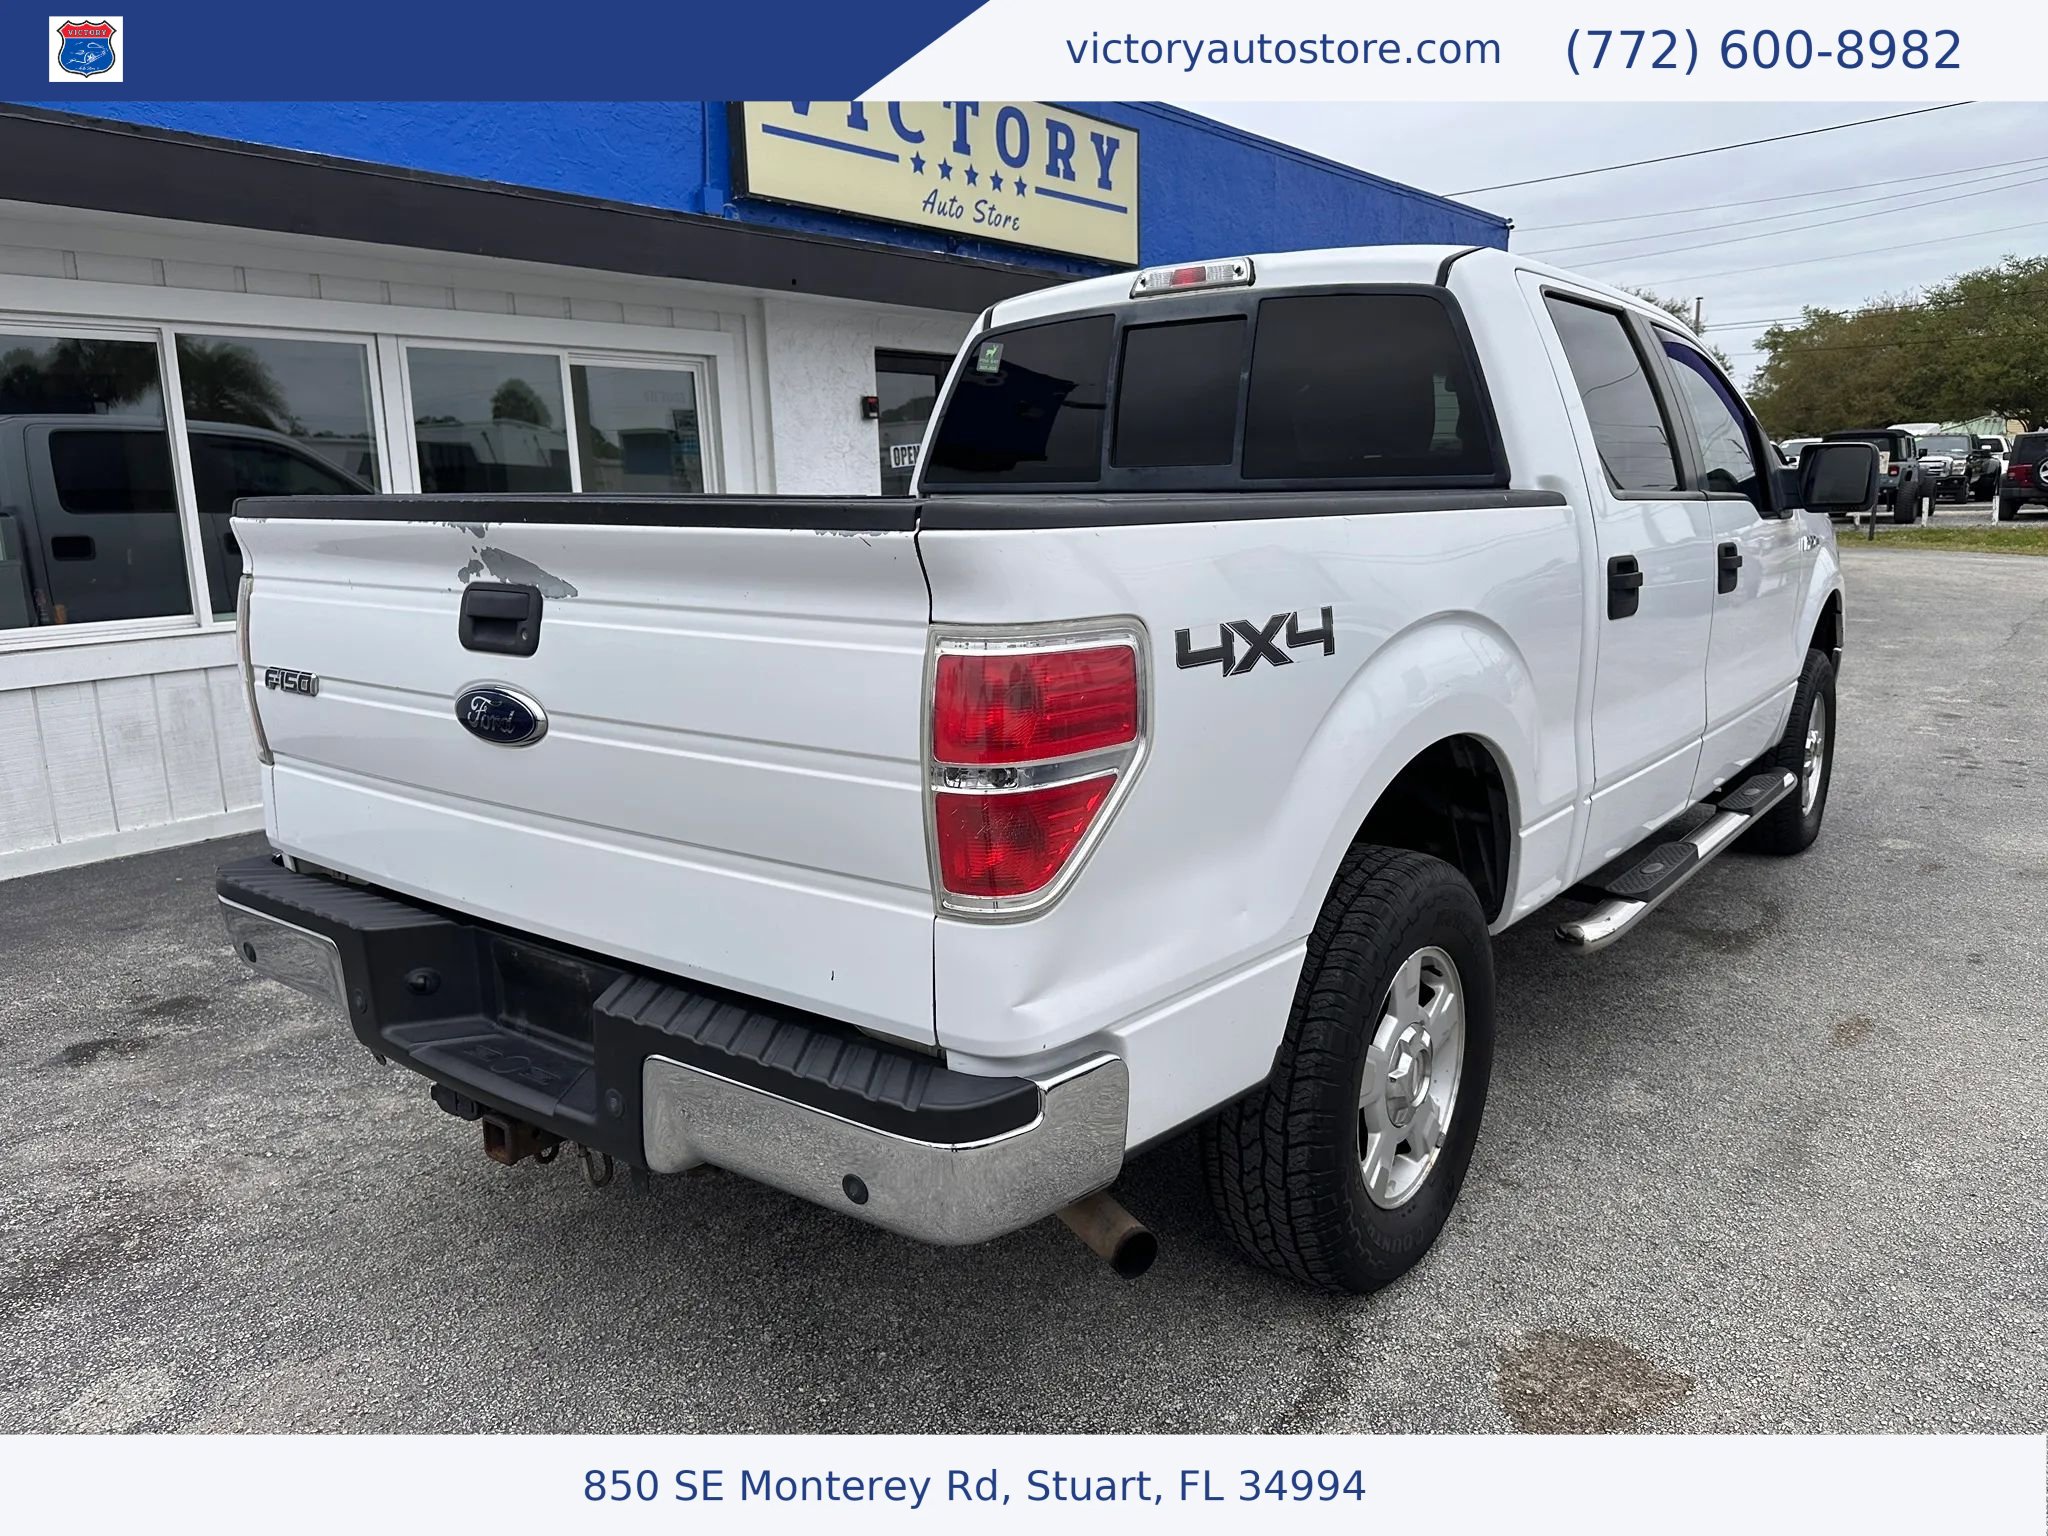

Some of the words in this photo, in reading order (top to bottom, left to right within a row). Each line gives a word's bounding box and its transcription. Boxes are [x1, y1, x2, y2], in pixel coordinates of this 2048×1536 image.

[791, 101, 1120, 191] CTORY
[922, 189, 964, 219] Auto
[973, 200, 1020, 231] Store
[265, 667, 315, 696] F-150
[467, 696, 515, 734] Ford
